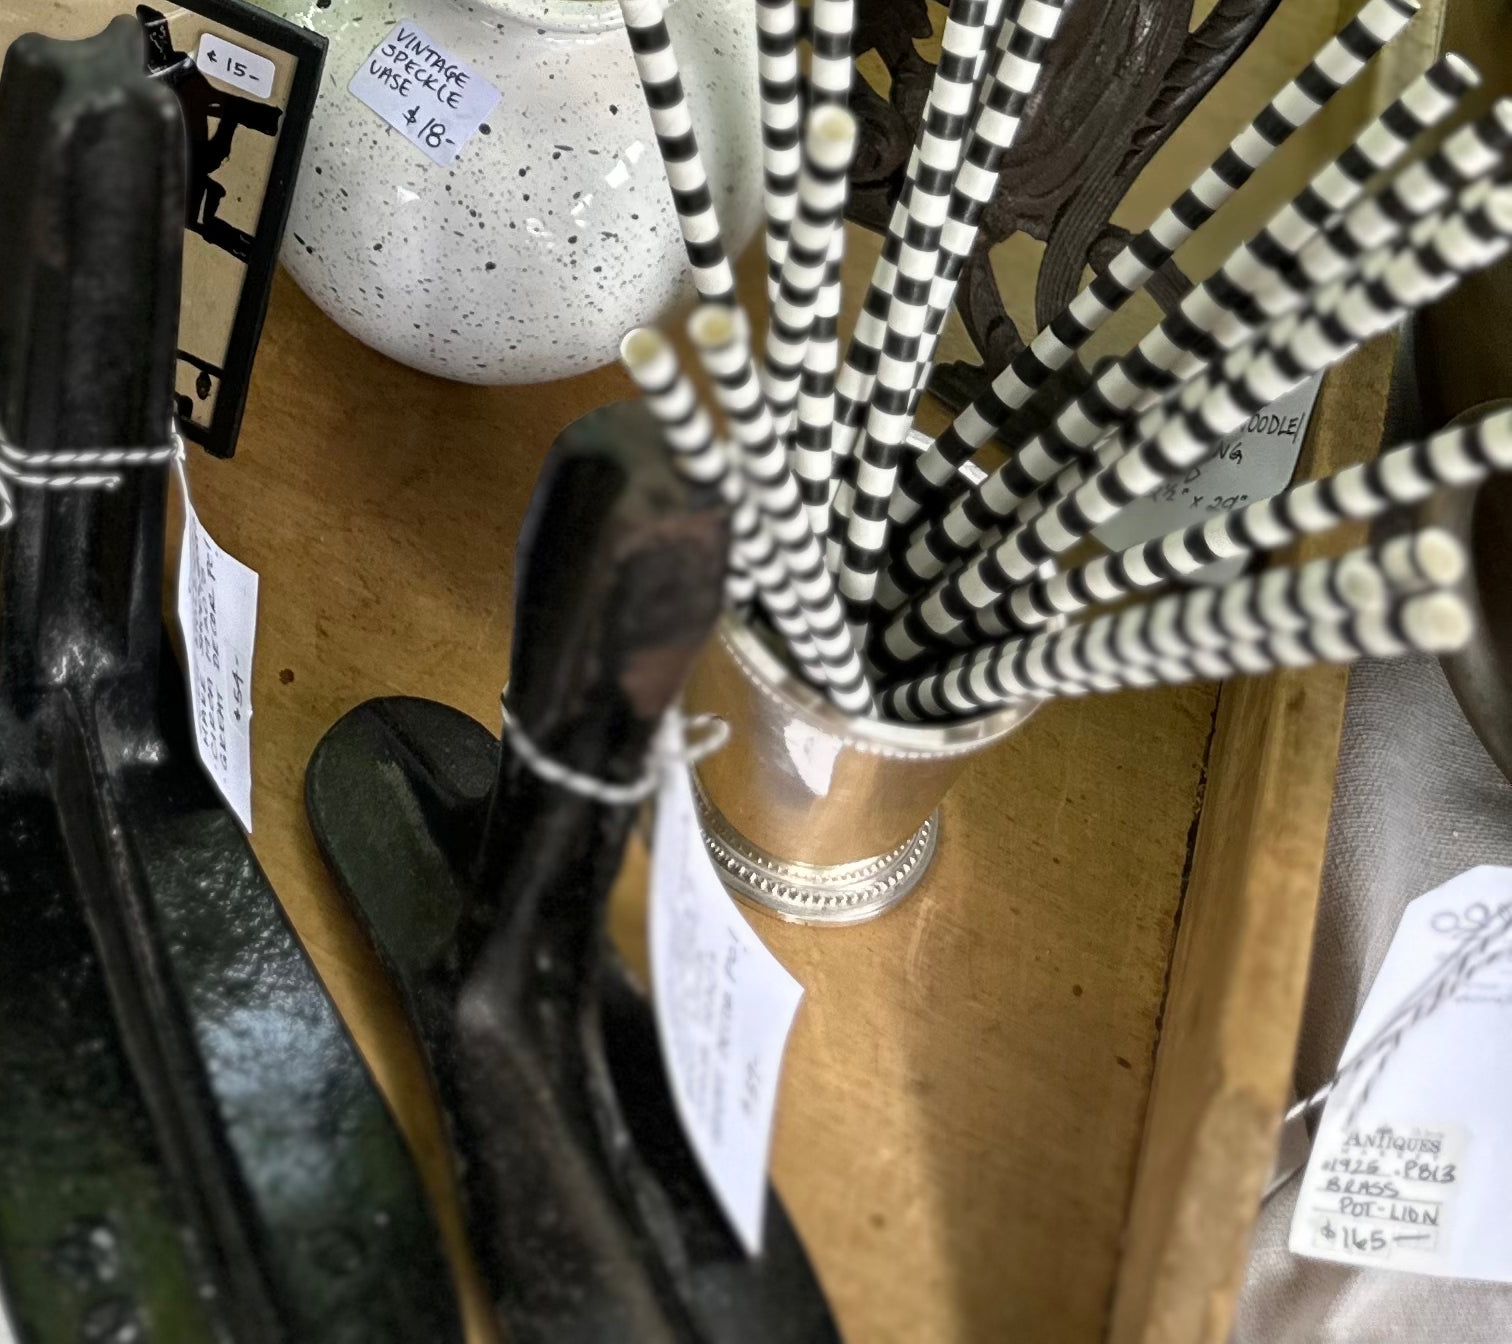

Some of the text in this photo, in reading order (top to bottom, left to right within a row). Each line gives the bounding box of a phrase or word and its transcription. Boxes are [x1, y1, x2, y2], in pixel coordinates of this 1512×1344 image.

[381, 44, 463, 109] SPECKLE
[397, 28, 471, 89] VINTAGE
[370, 60, 412, 97] VASE
[1343, 1127, 1442, 1154] ANTIQUES
[1326, 1177, 1400, 1198] BRASS
